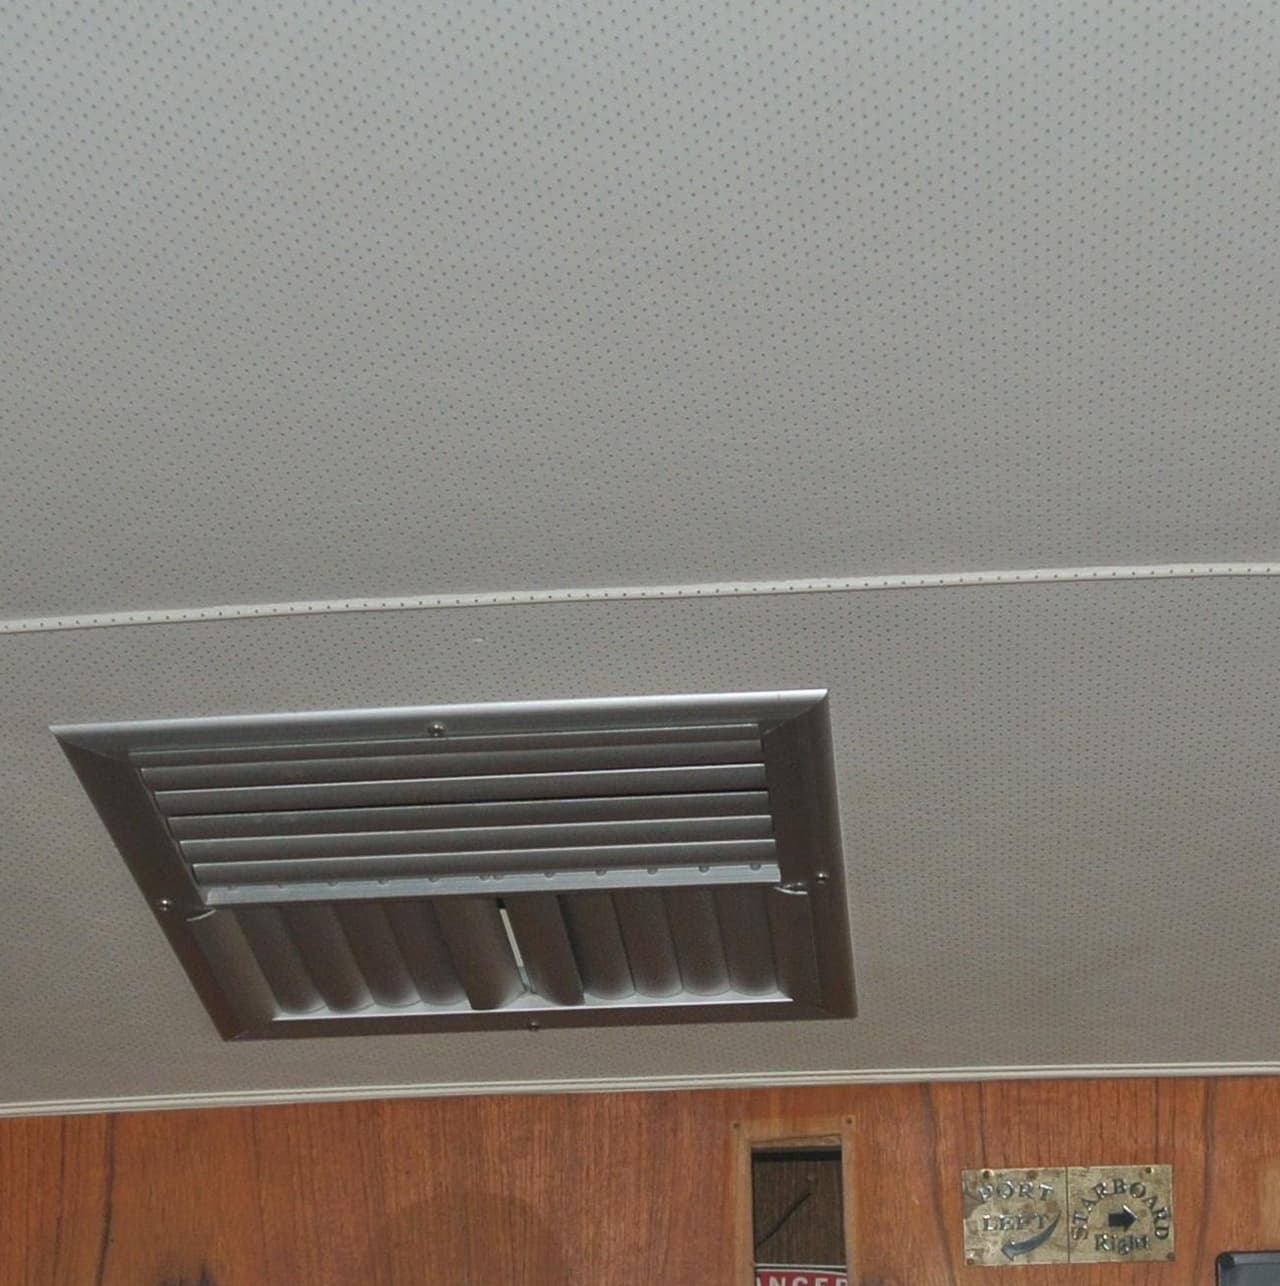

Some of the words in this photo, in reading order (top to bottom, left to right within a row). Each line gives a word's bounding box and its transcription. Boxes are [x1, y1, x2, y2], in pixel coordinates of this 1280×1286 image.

[978, 1180, 1054, 1201] PORT
[1071, 1178, 1170, 1240] STARBOARD
[983, 1213, 1049, 1231] LEFT
[1095, 1233, 1150, 1255] Right
